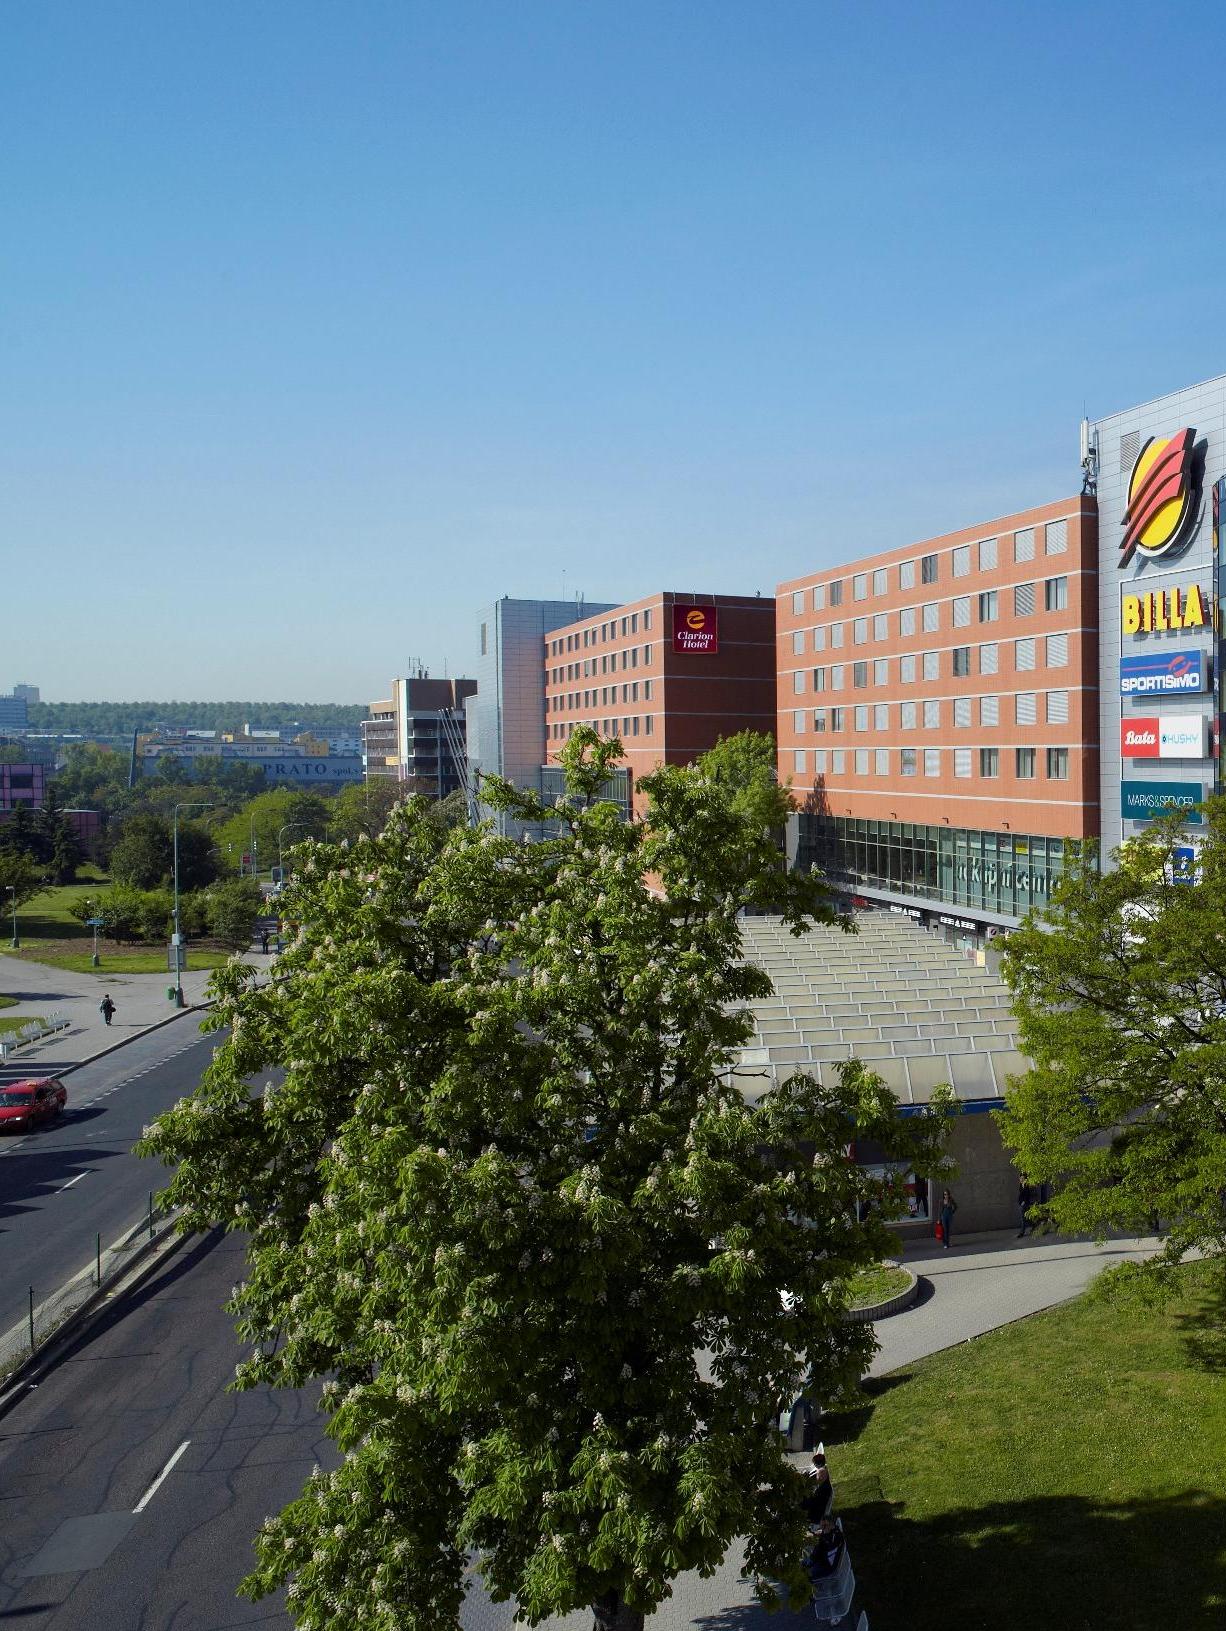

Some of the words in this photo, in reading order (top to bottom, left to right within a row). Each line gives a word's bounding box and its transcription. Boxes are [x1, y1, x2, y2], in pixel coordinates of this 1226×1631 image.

[1122, 584, 1204, 635] BILLA
[677, 631, 713, 640] Clarion
[683, 640, 709, 649] Hotel
[1121, 672, 1200, 692] SPORTISIMO
[1125, 731, 1156, 745] Bata
[263, 763, 327, 775] PRATO
